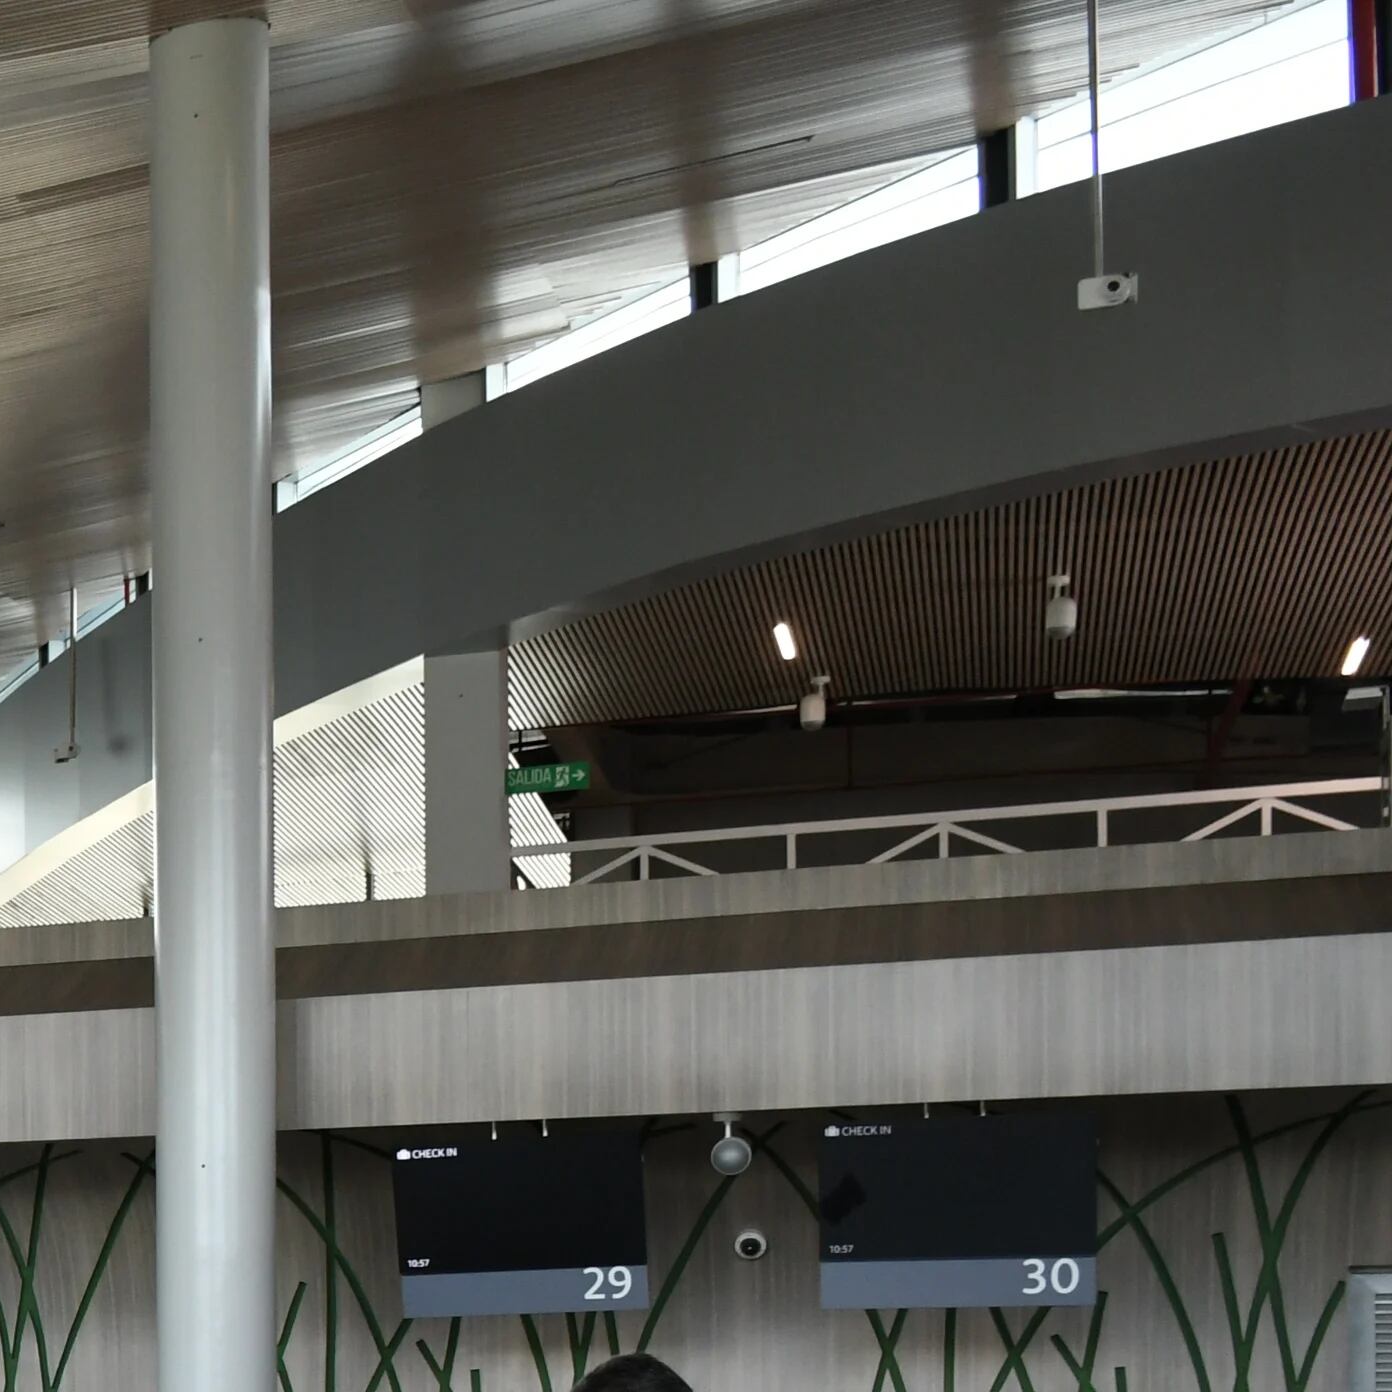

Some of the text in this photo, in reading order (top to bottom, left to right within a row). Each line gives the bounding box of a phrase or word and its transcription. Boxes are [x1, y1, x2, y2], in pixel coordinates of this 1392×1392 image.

[508, 767, 551, 786] SALIDA
[841, 1125, 892, 1137] CHECK IN
[412, 1147, 458, 1160] CHECK IN
[829, 1245, 854, 1254] 10:57
[407, 1259, 430, 1268] 10:57
[1022, 1257, 1080, 1294] 30
[582, 1266, 632, 1300] 29
